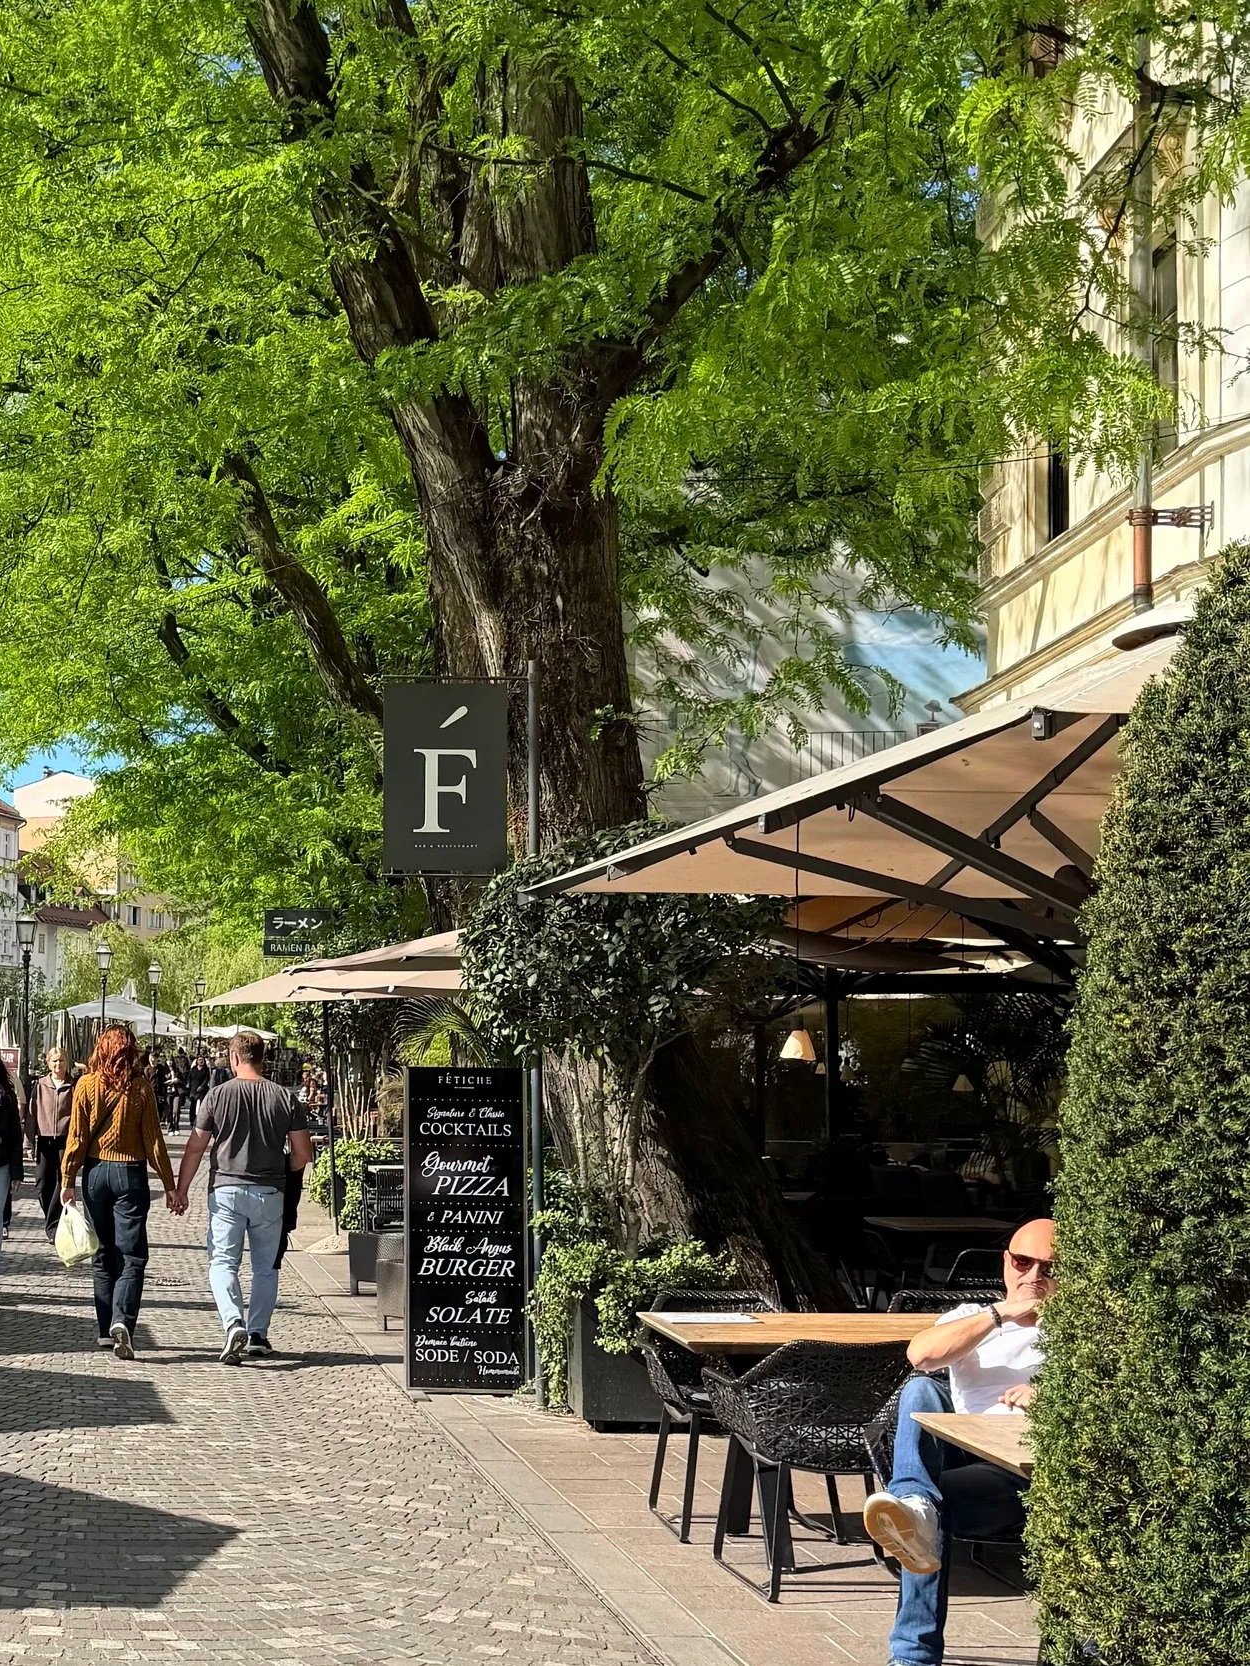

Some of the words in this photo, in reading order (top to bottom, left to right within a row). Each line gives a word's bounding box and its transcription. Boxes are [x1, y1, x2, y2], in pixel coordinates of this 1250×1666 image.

[272, 916, 323, 930] ラーメン
[270, 943, 303, 953] RAMEN
[438, 1072, 492, 1085] FÉTICHE
[427, 1106, 465, 1120] Signature
[468, 1108, 476, 1118] &
[479, 1106, 505, 1119] Classic
[419, 1122, 512, 1137] COCKTAILS
[420, 1151, 494, 1178] Gourmet
[431, 1175, 510, 1197] PIZZA
[440, 1210, 504, 1225] PANINI
[424, 1235, 465, 1253] Black
[465, 1237, 513, 1258] Angus
[417, 1258, 516, 1277] BURGER
[465, 1290, 498, 1305] Salads
[425, 1306, 513, 1325] SOLATE
[415, 1348, 460, 1363] SODE
[473, 1350, 520, 1365] SODA
